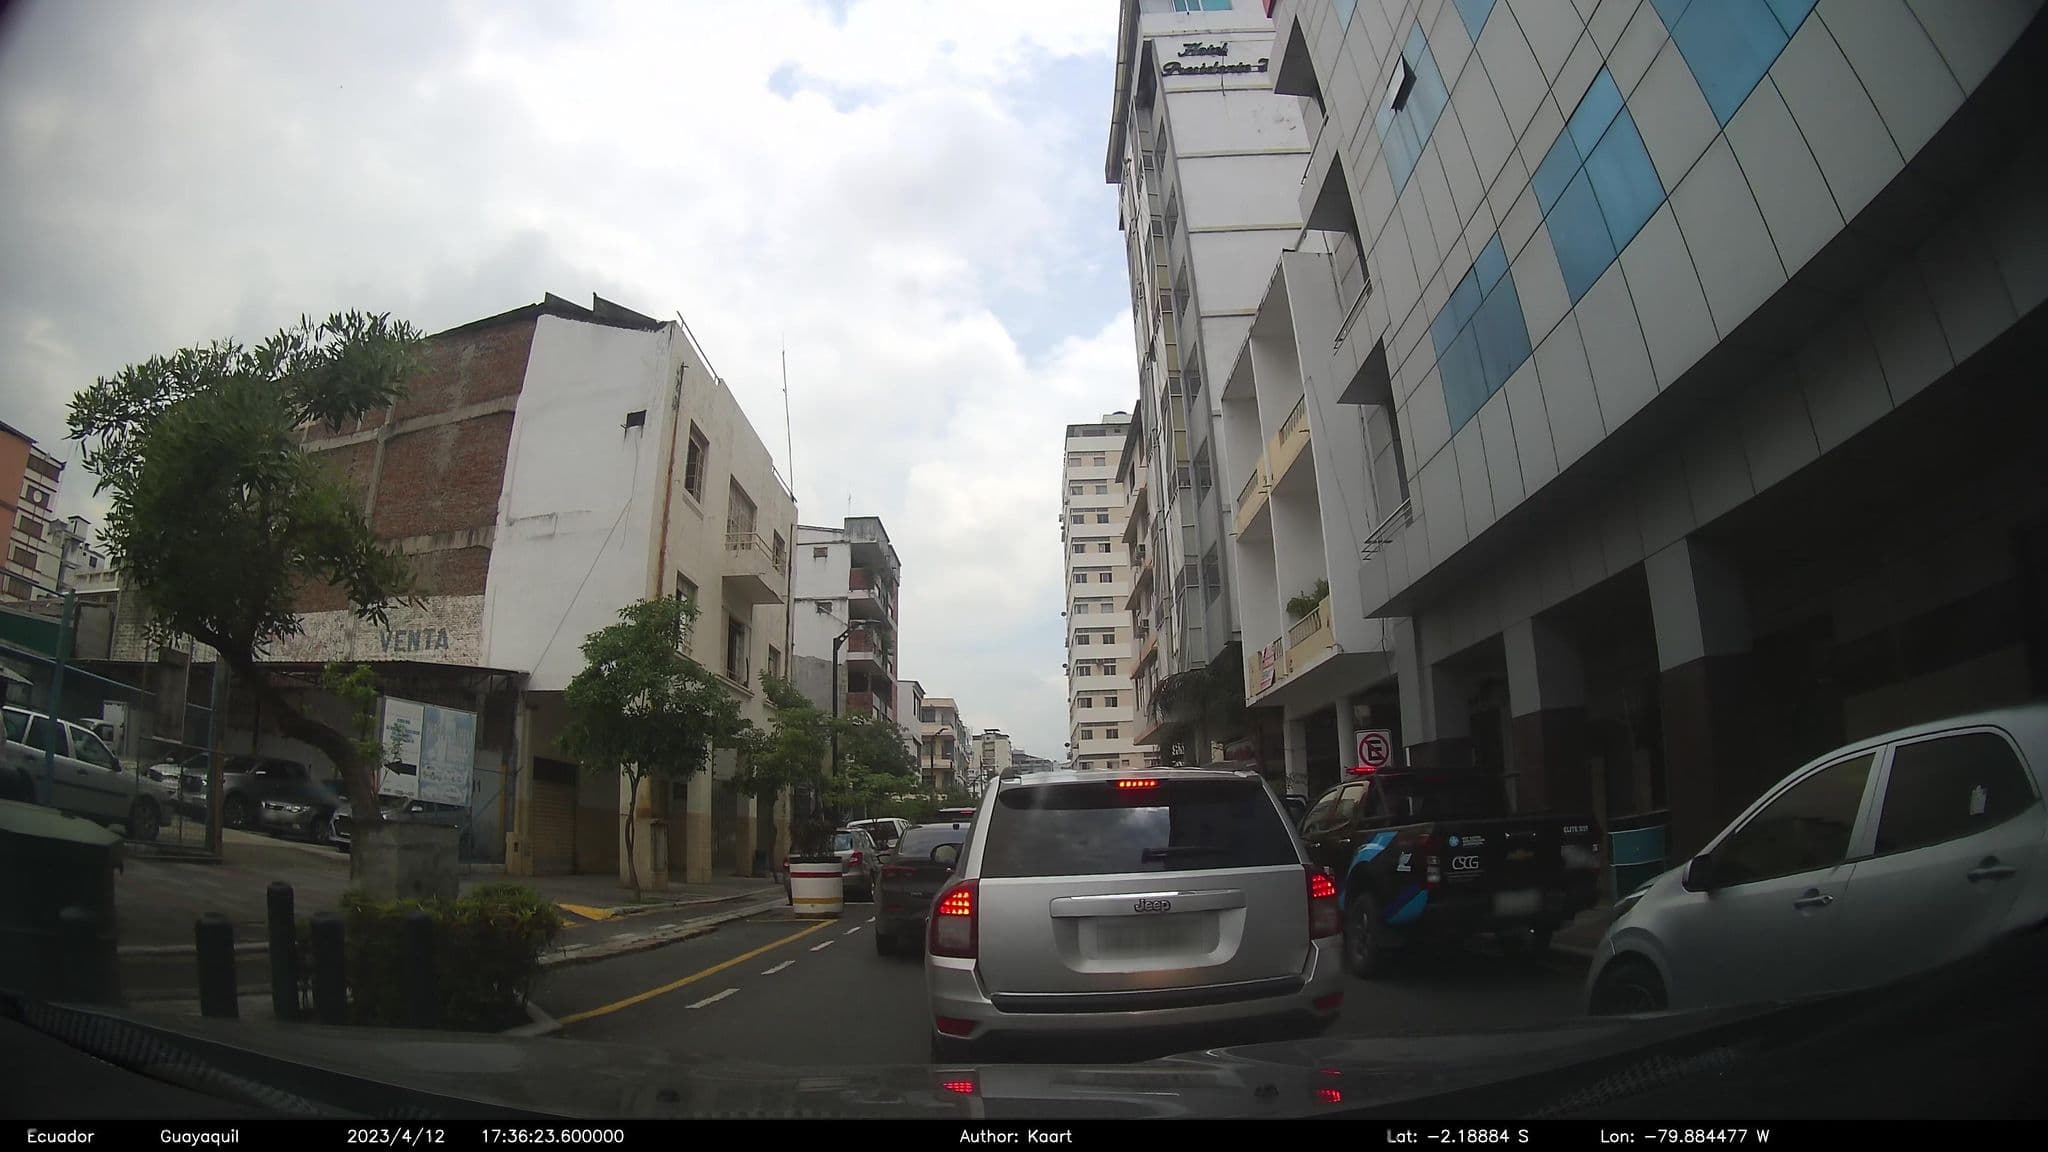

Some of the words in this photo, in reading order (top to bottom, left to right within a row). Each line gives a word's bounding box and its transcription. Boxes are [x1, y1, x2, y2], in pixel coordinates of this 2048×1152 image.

[1177, 42, 1228, 57] Hotel
[379, 627, 449, 653] VENTA
[1366, 740, 1383, 761] E
[1452, 855, 1479, 870] CSCG
[1134, 898, 1171, 914] Jeep
